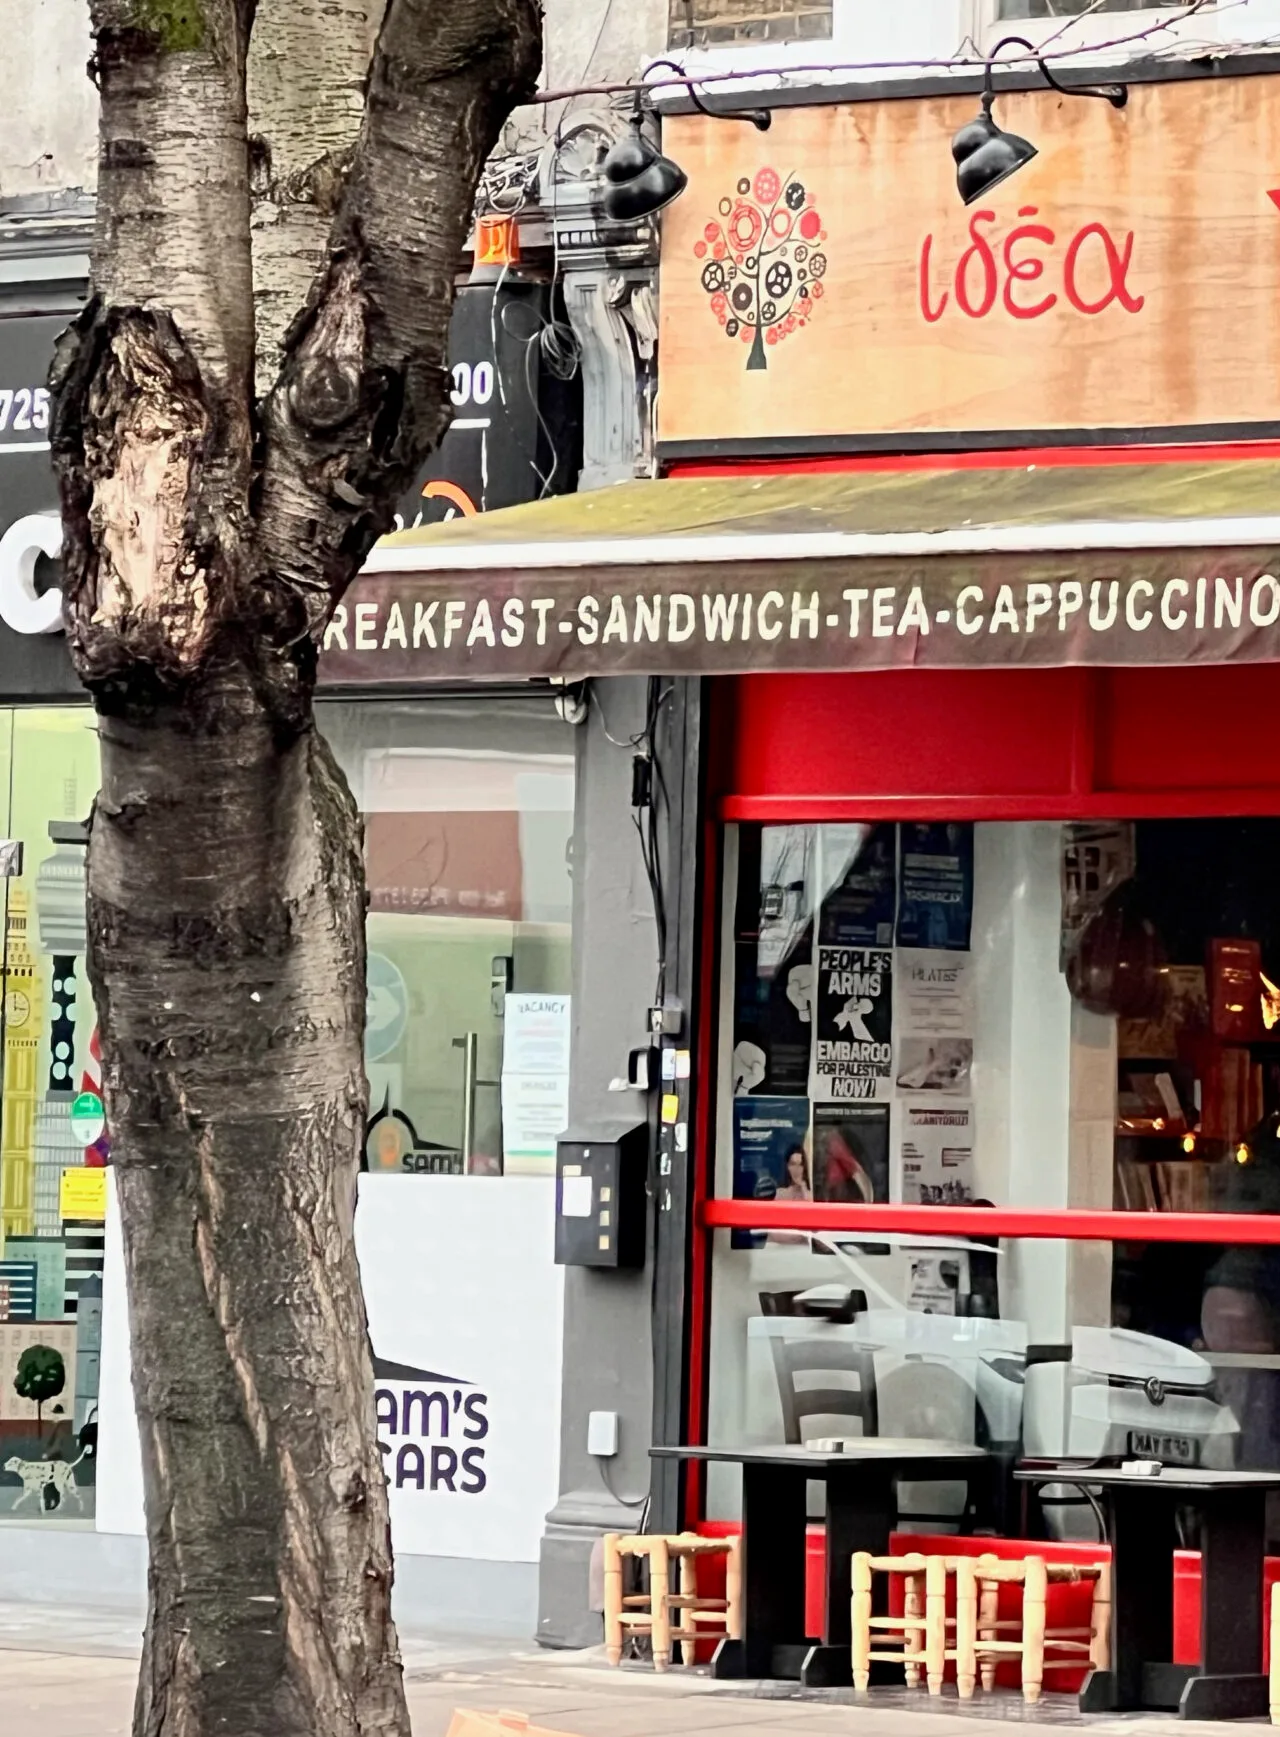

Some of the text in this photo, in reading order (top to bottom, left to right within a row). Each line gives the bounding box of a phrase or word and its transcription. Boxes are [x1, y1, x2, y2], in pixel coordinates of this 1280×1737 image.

[820, 949, 891, 972] PEOPLE'S
[828, 971, 881, 997] ARMS
[517, 1002, 566, 1014] VACANCY
[817, 1040, 891, 1062] EMBARGO
[816, 1062, 891, 1077] FOR PALESTINE
[833, 1078, 876, 1098] NOW!
[375, 1388, 489, 1440] AM'S
